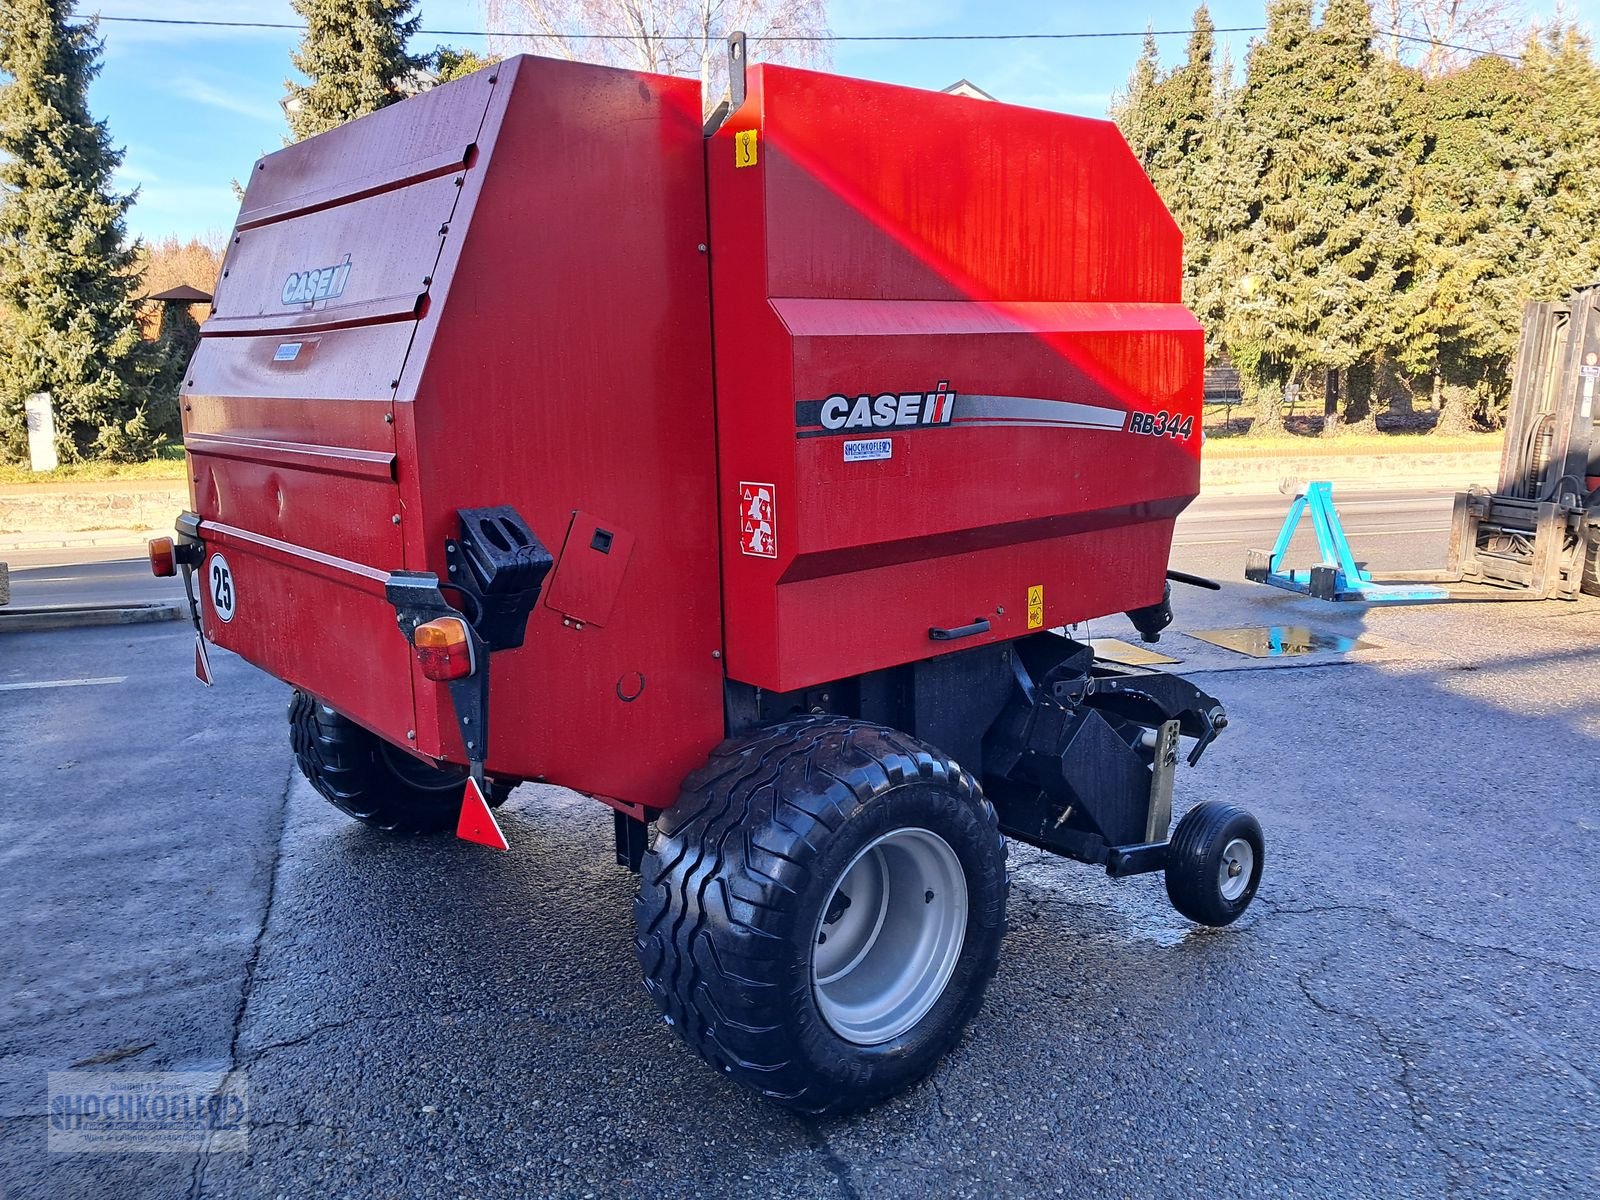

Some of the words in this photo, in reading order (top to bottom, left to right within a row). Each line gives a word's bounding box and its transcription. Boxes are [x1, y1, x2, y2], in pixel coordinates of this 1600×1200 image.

[282, 268, 334, 303] CASE
[820, 395, 922, 430] CASE
[1129, 410, 1194, 440] RB344
[213, 565, 232, 611] 25
